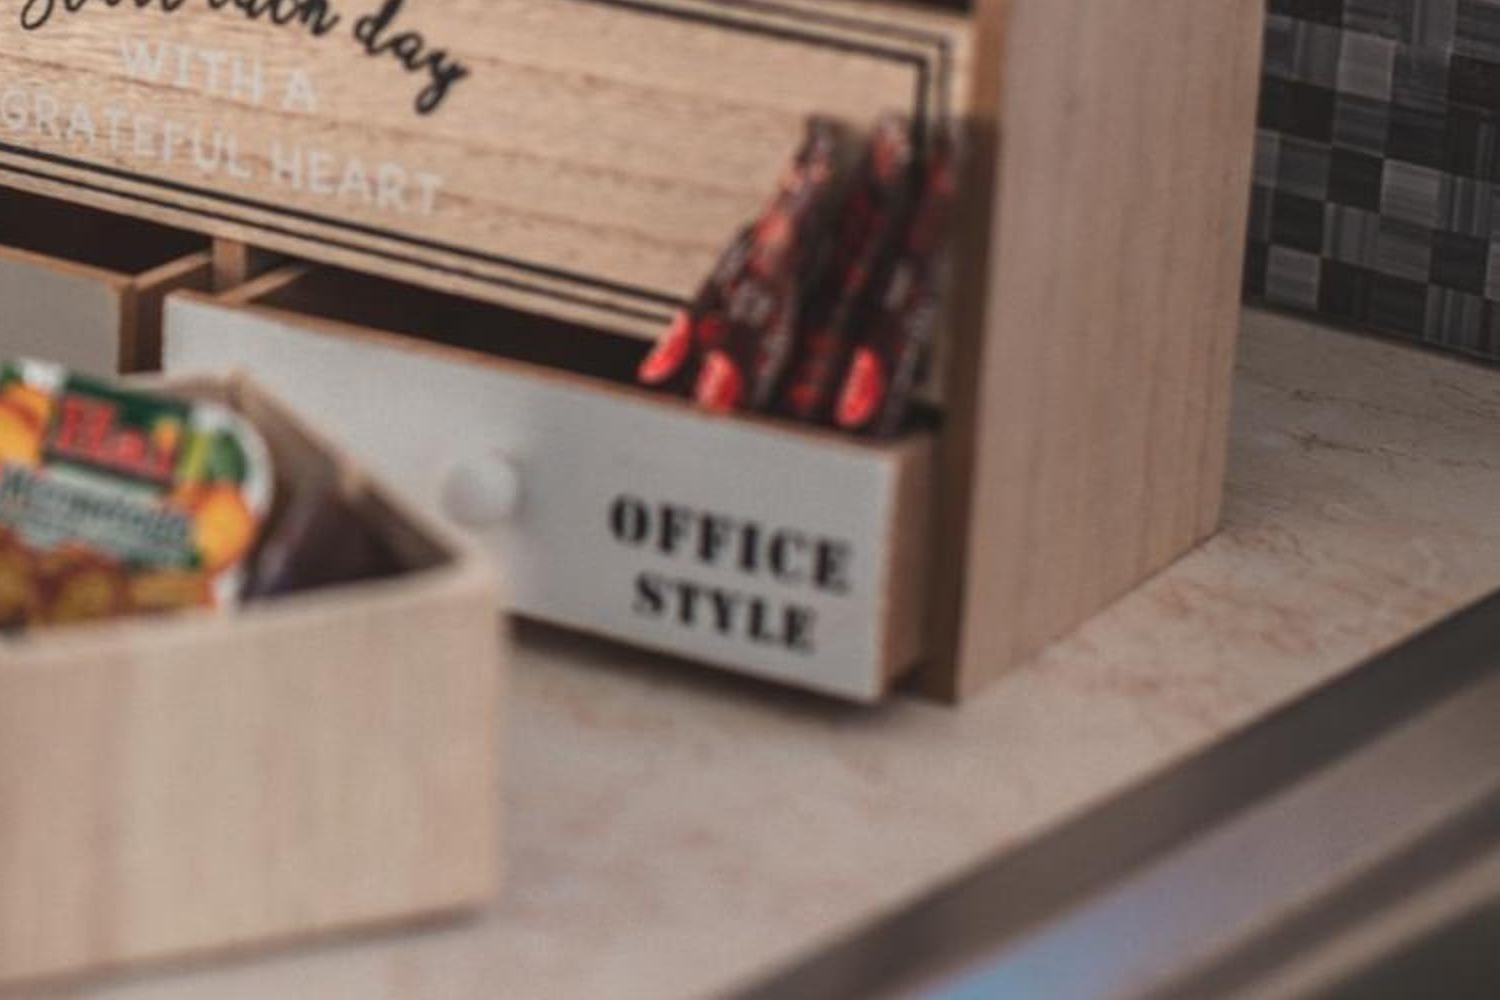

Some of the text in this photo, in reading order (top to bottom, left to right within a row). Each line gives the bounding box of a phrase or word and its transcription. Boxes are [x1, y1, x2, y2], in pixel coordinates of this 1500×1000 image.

[119, 38, 318, 112] WITH A
[269, 140, 446, 217] HEART
[609, 494, 851, 596] OFFICE
[633, 572, 816, 655] STYLE
